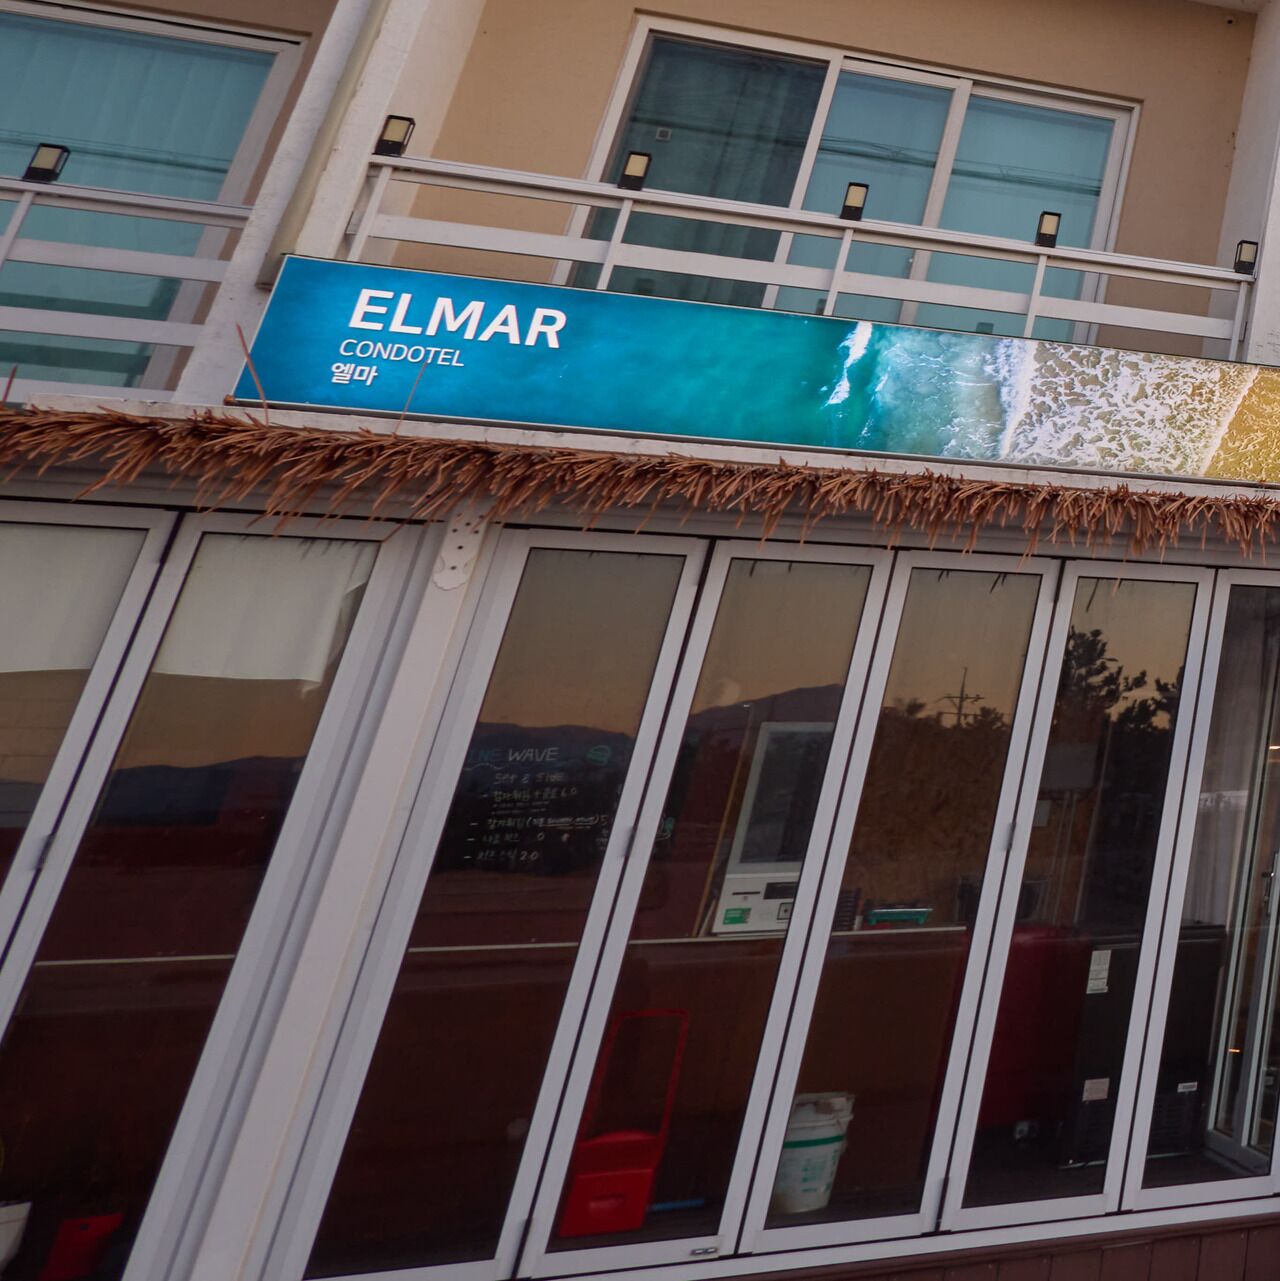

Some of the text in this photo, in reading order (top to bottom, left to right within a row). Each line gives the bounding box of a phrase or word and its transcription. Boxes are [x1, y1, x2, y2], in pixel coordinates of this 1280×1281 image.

[348, 287, 568, 350] ELMAR
[339, 338, 465, 368] CONDOTEL
[330, 362, 379, 387] 엘마
[507, 746, 560, 762] WAVE
